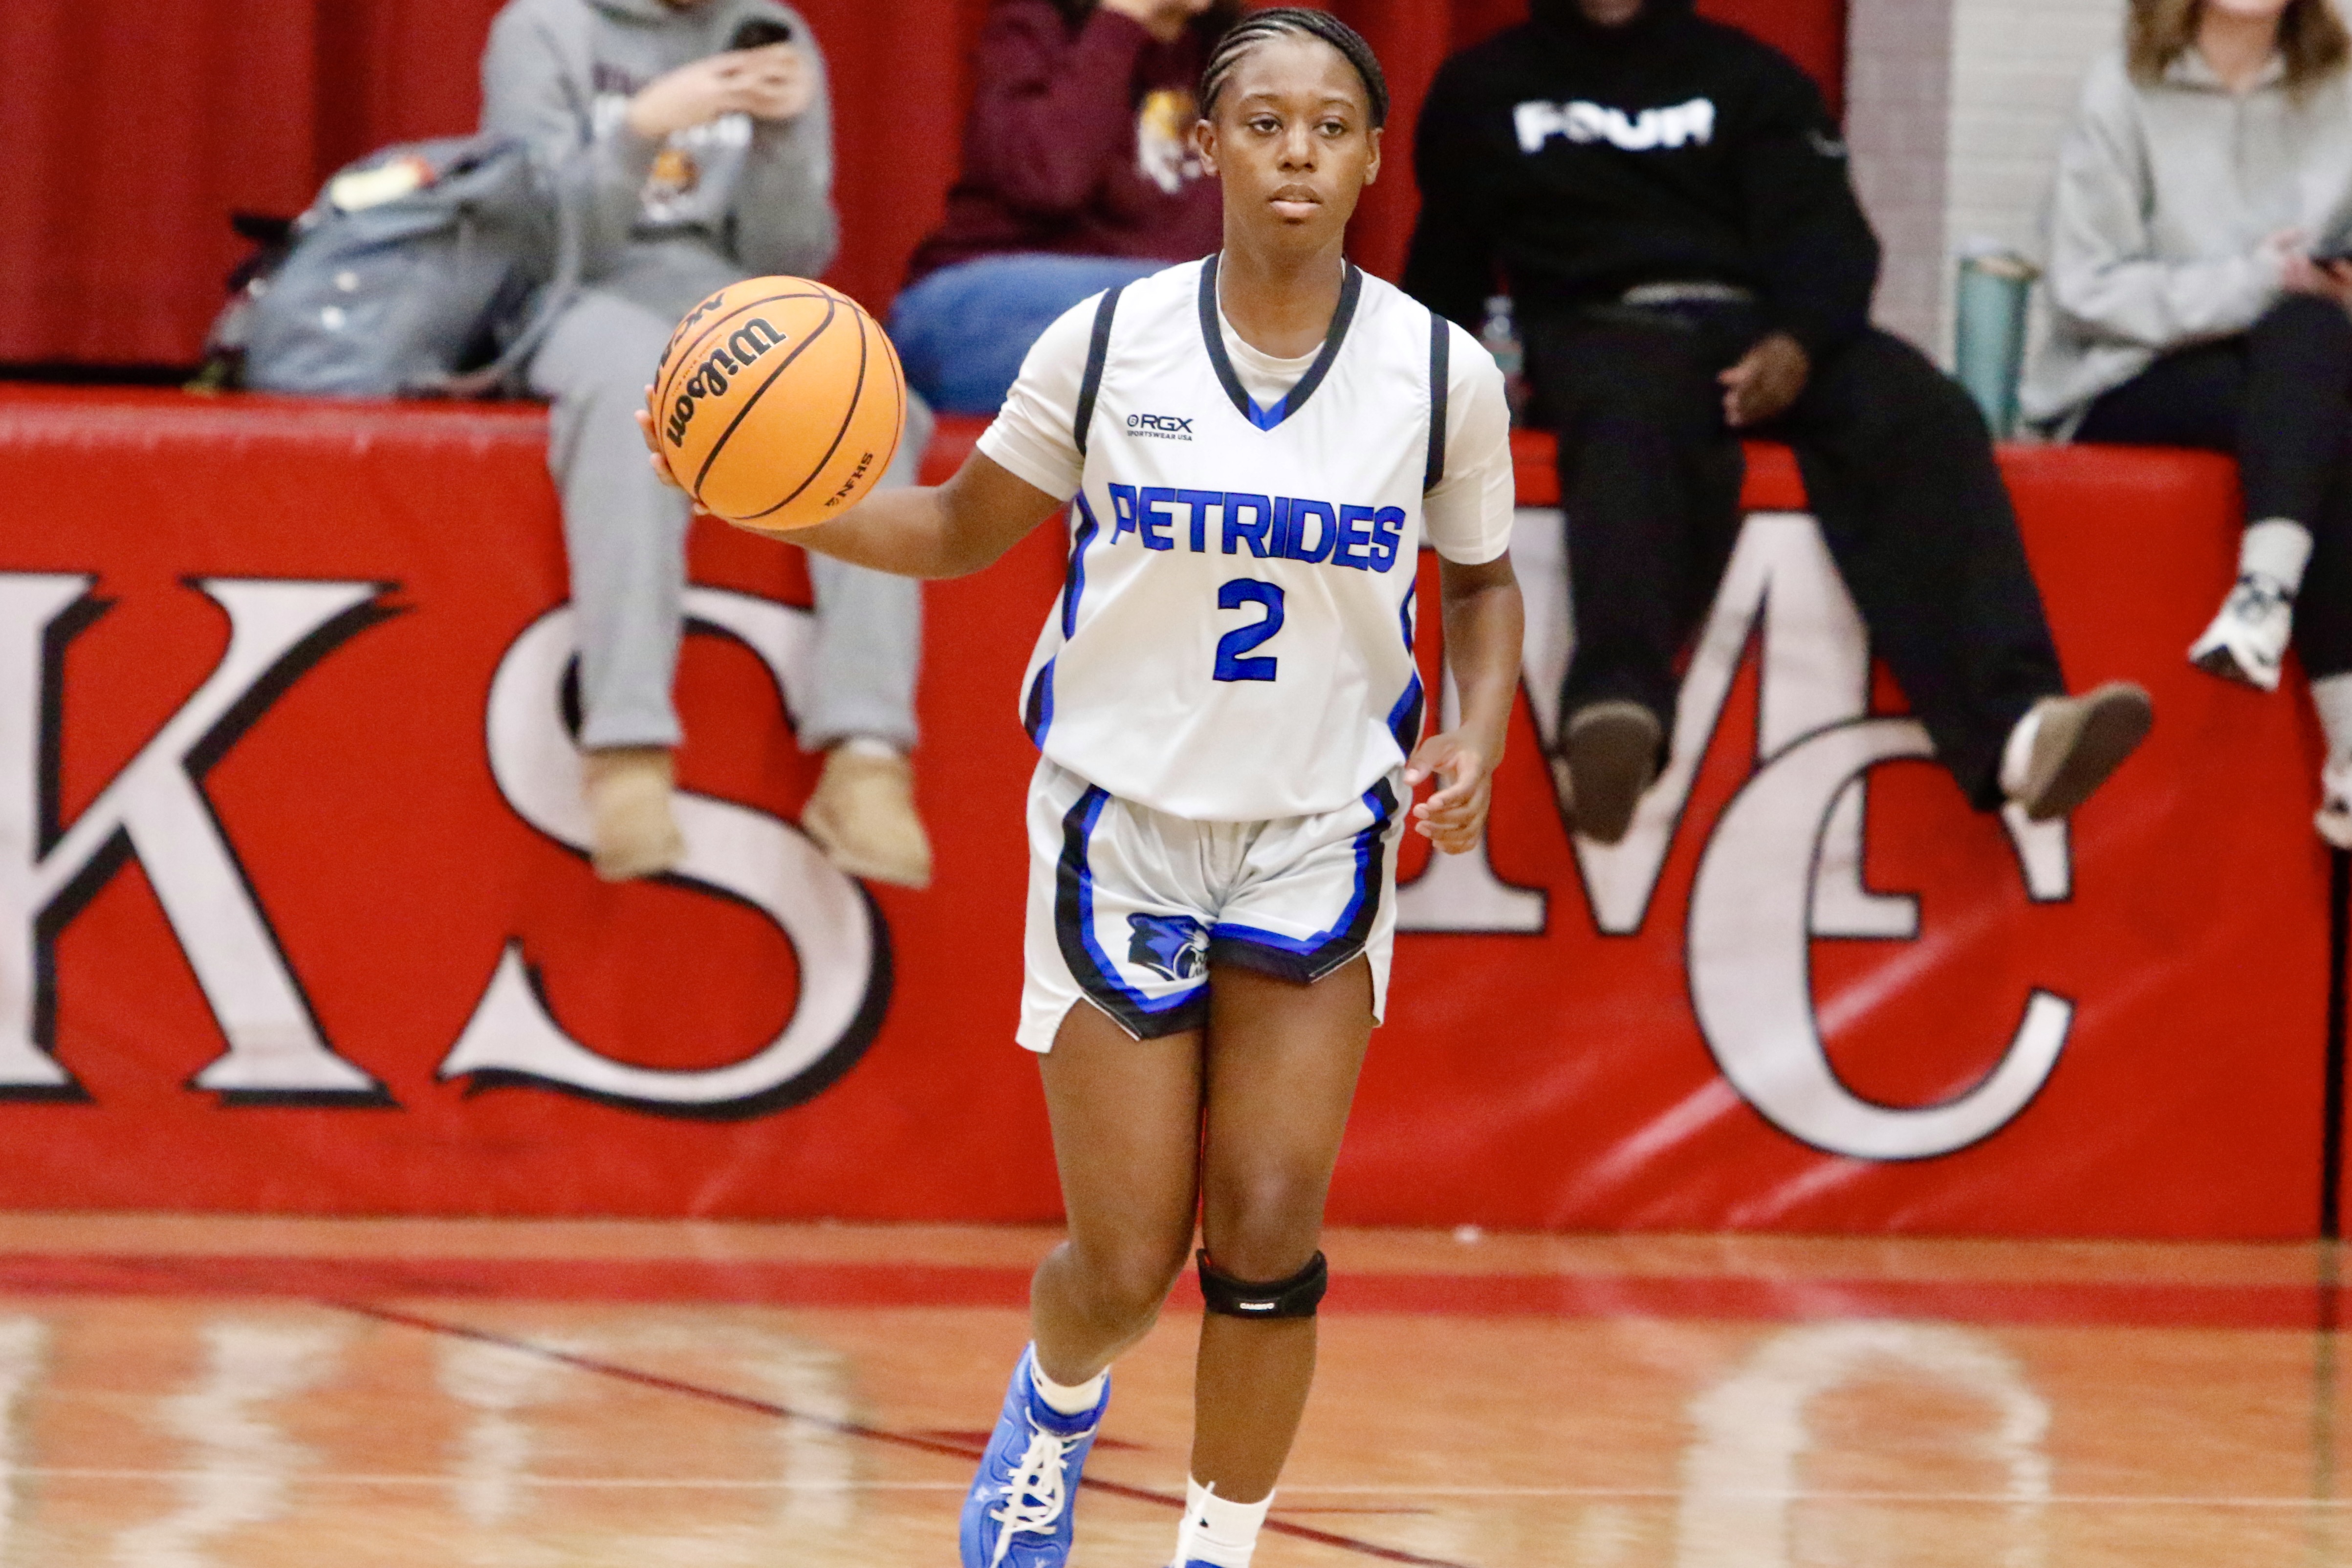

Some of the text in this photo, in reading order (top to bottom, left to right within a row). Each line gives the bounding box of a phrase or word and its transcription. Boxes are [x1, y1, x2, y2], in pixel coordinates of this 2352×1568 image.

[666, 317, 786, 448] Wilson
[1127, 430, 1176, 440] SPORTSWEAR
[1140, 414, 1193, 434] RGX
[836, 453, 873, 498] NFHS
[1107, 482, 1406, 573] PETRIDES
[1212, 577, 1285, 682] 2
